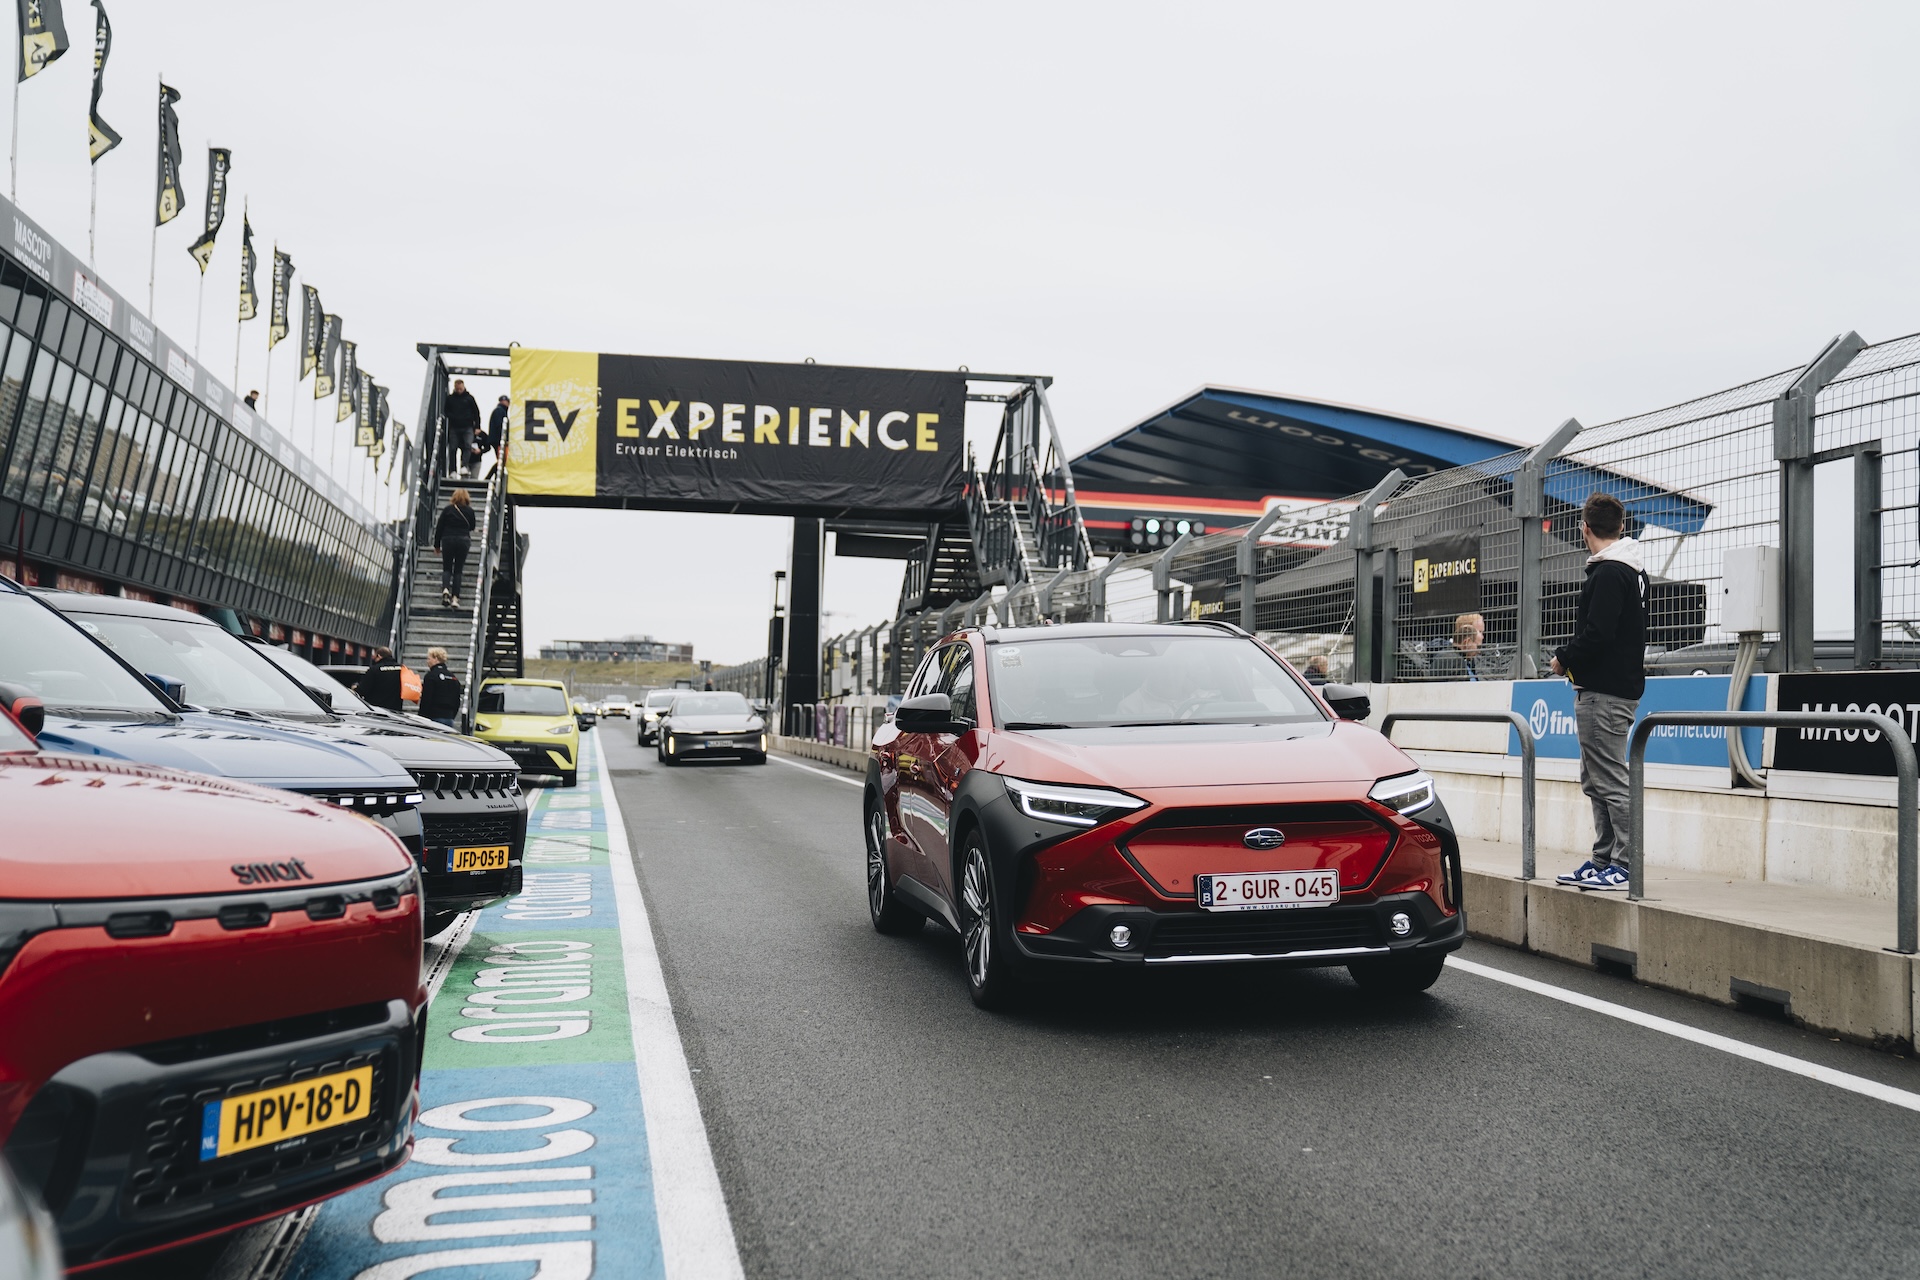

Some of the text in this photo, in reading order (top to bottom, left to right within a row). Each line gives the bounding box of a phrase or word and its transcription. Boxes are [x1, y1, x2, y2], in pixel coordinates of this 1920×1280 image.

[524, 398, 940, 452] EV EXPERIENCE
[615, 443, 737, 459] Ervaar Elektrisch
[1429, 558, 1476, 579] EXPERIENCE
[230, 857, 314, 885] smart
[456, 850, 504, 868] JFD-05-B
[1203, 893, 1211, 902] B
[449, 940, 594, 1043] aramco
[202, 1078, 360, 1151] NL HPV-18-D
